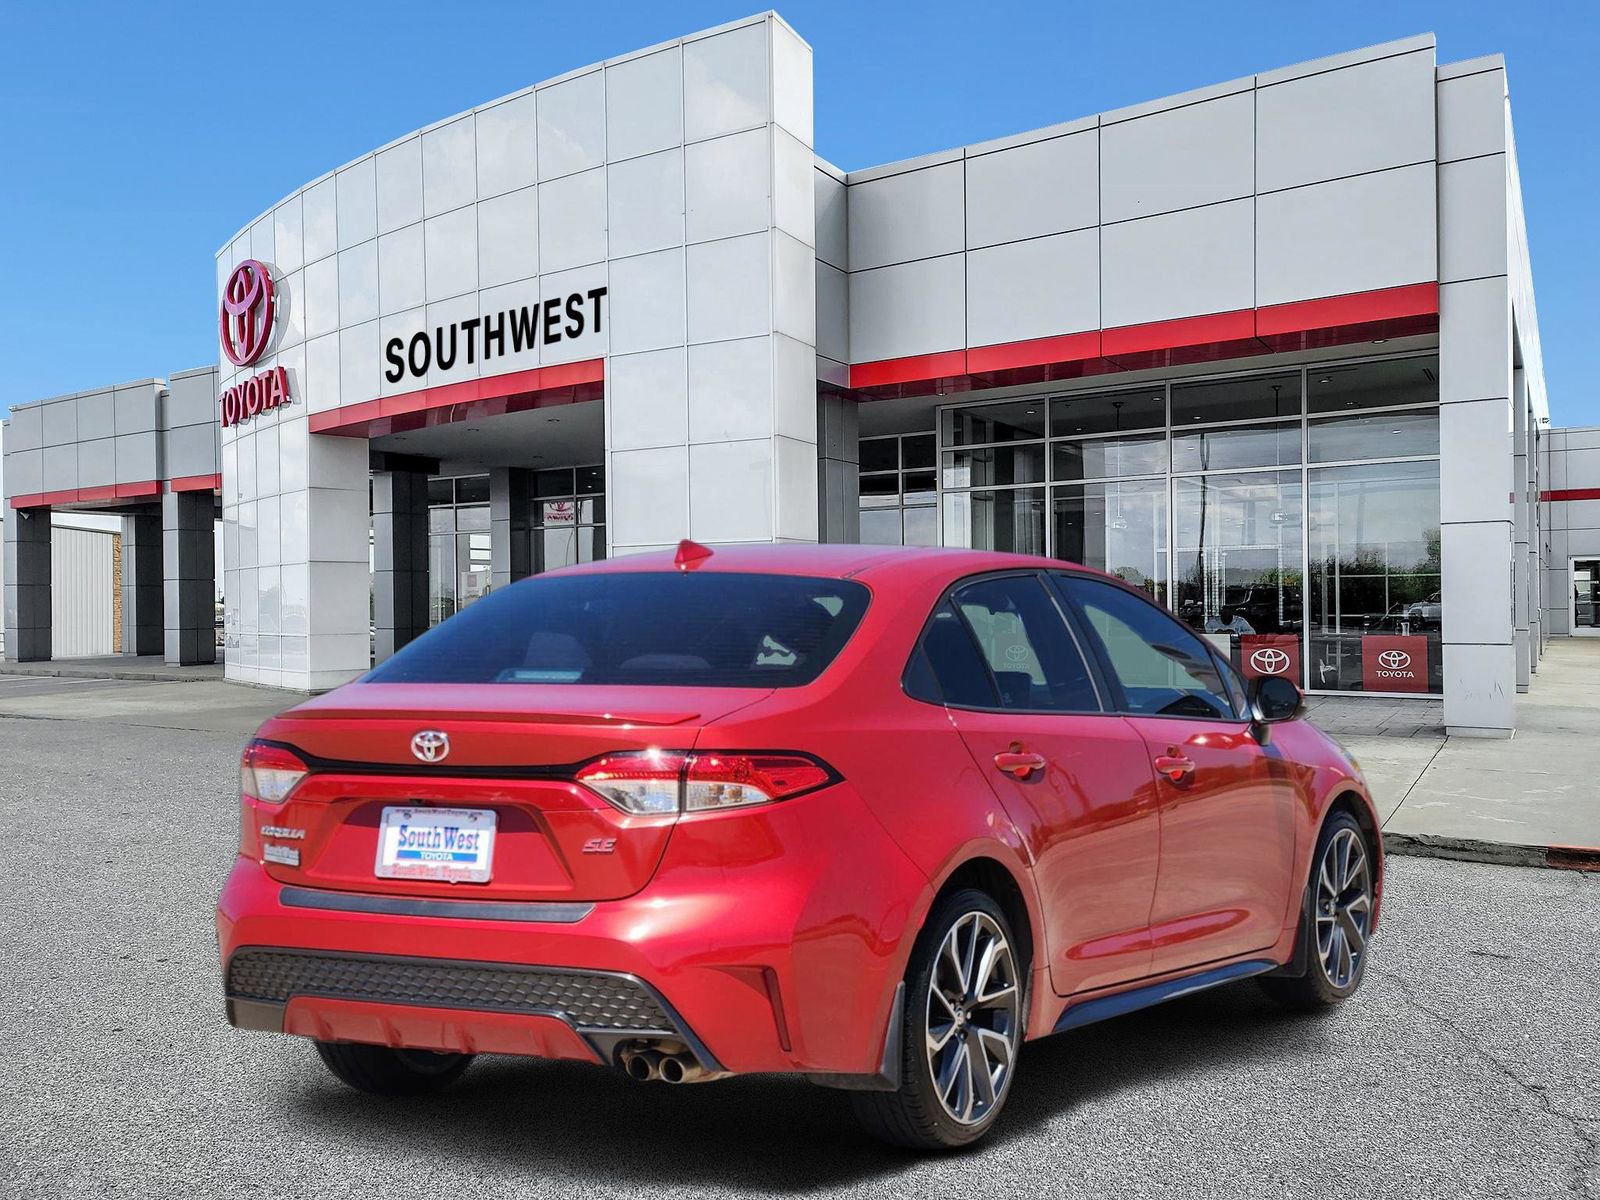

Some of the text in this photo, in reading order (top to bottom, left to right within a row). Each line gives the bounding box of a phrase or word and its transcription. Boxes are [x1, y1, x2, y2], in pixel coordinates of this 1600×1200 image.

[385, 286, 608, 384] SOUTHWEST
[219, 366, 291, 428] TOYOTA
[1376, 670, 1414, 678] TOYOTA
[582, 838, 617, 853] SE
[420, 851, 454, 861] TOYOTA
